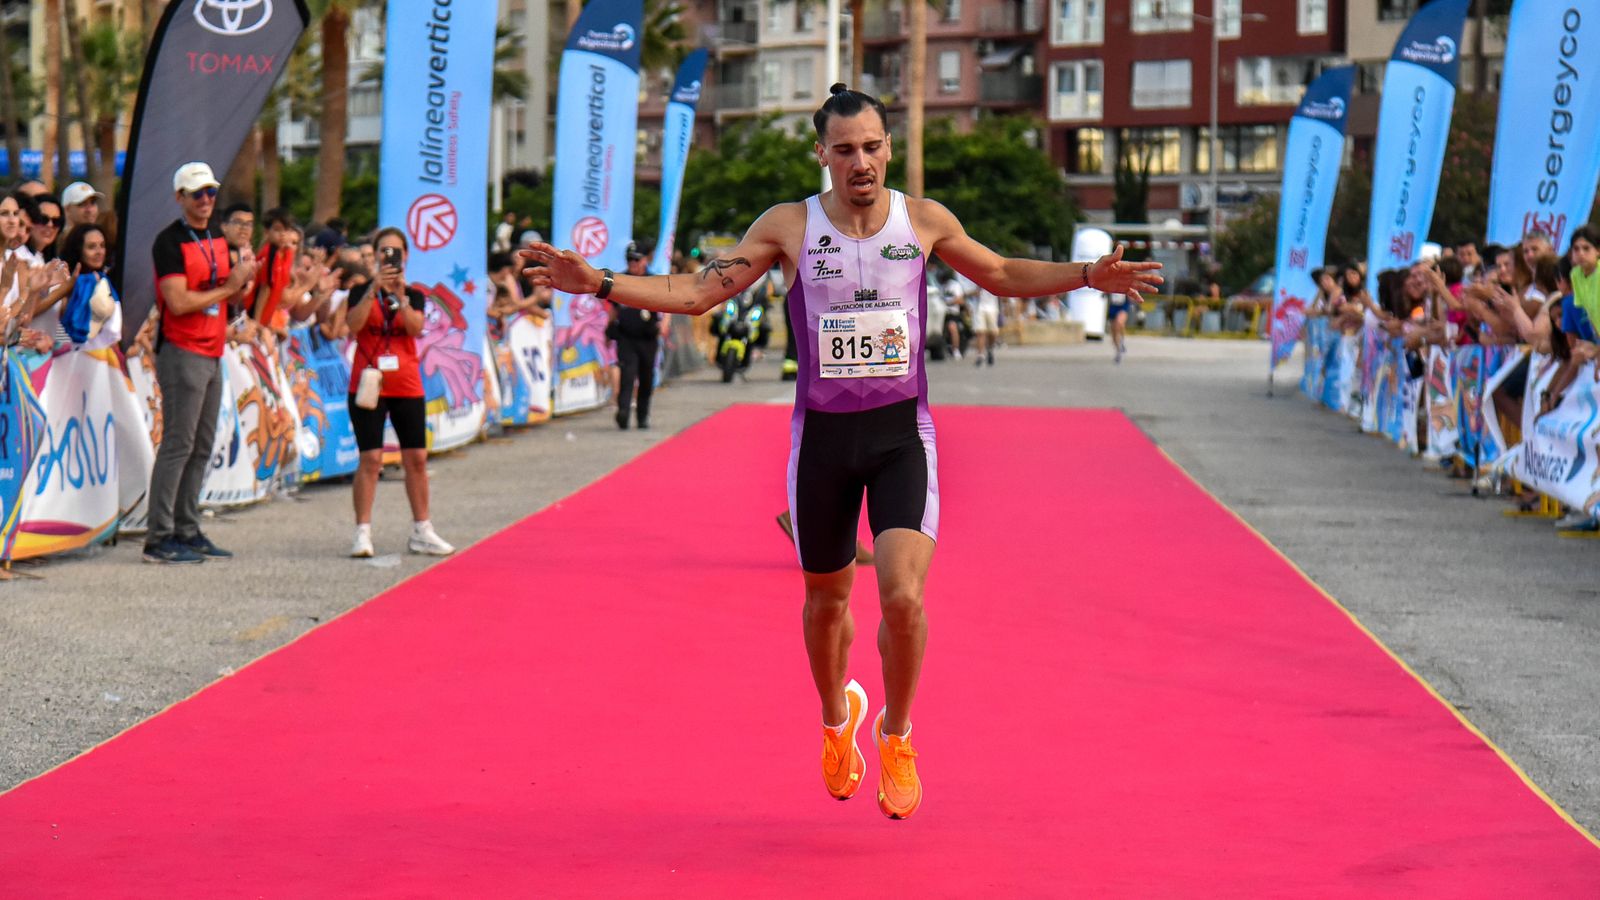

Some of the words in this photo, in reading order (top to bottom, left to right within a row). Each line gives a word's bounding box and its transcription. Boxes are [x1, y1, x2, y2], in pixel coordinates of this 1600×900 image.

[187, 52, 275, 74] TOMAX
[1537, 7, 1581, 206] Sergeyco
[808, 247, 841, 255] VIATOR
[830, 302, 863, 312] DIPUTACIÓN
[823, 319, 838, 329] XXI
[832, 335, 873, 360] 815
